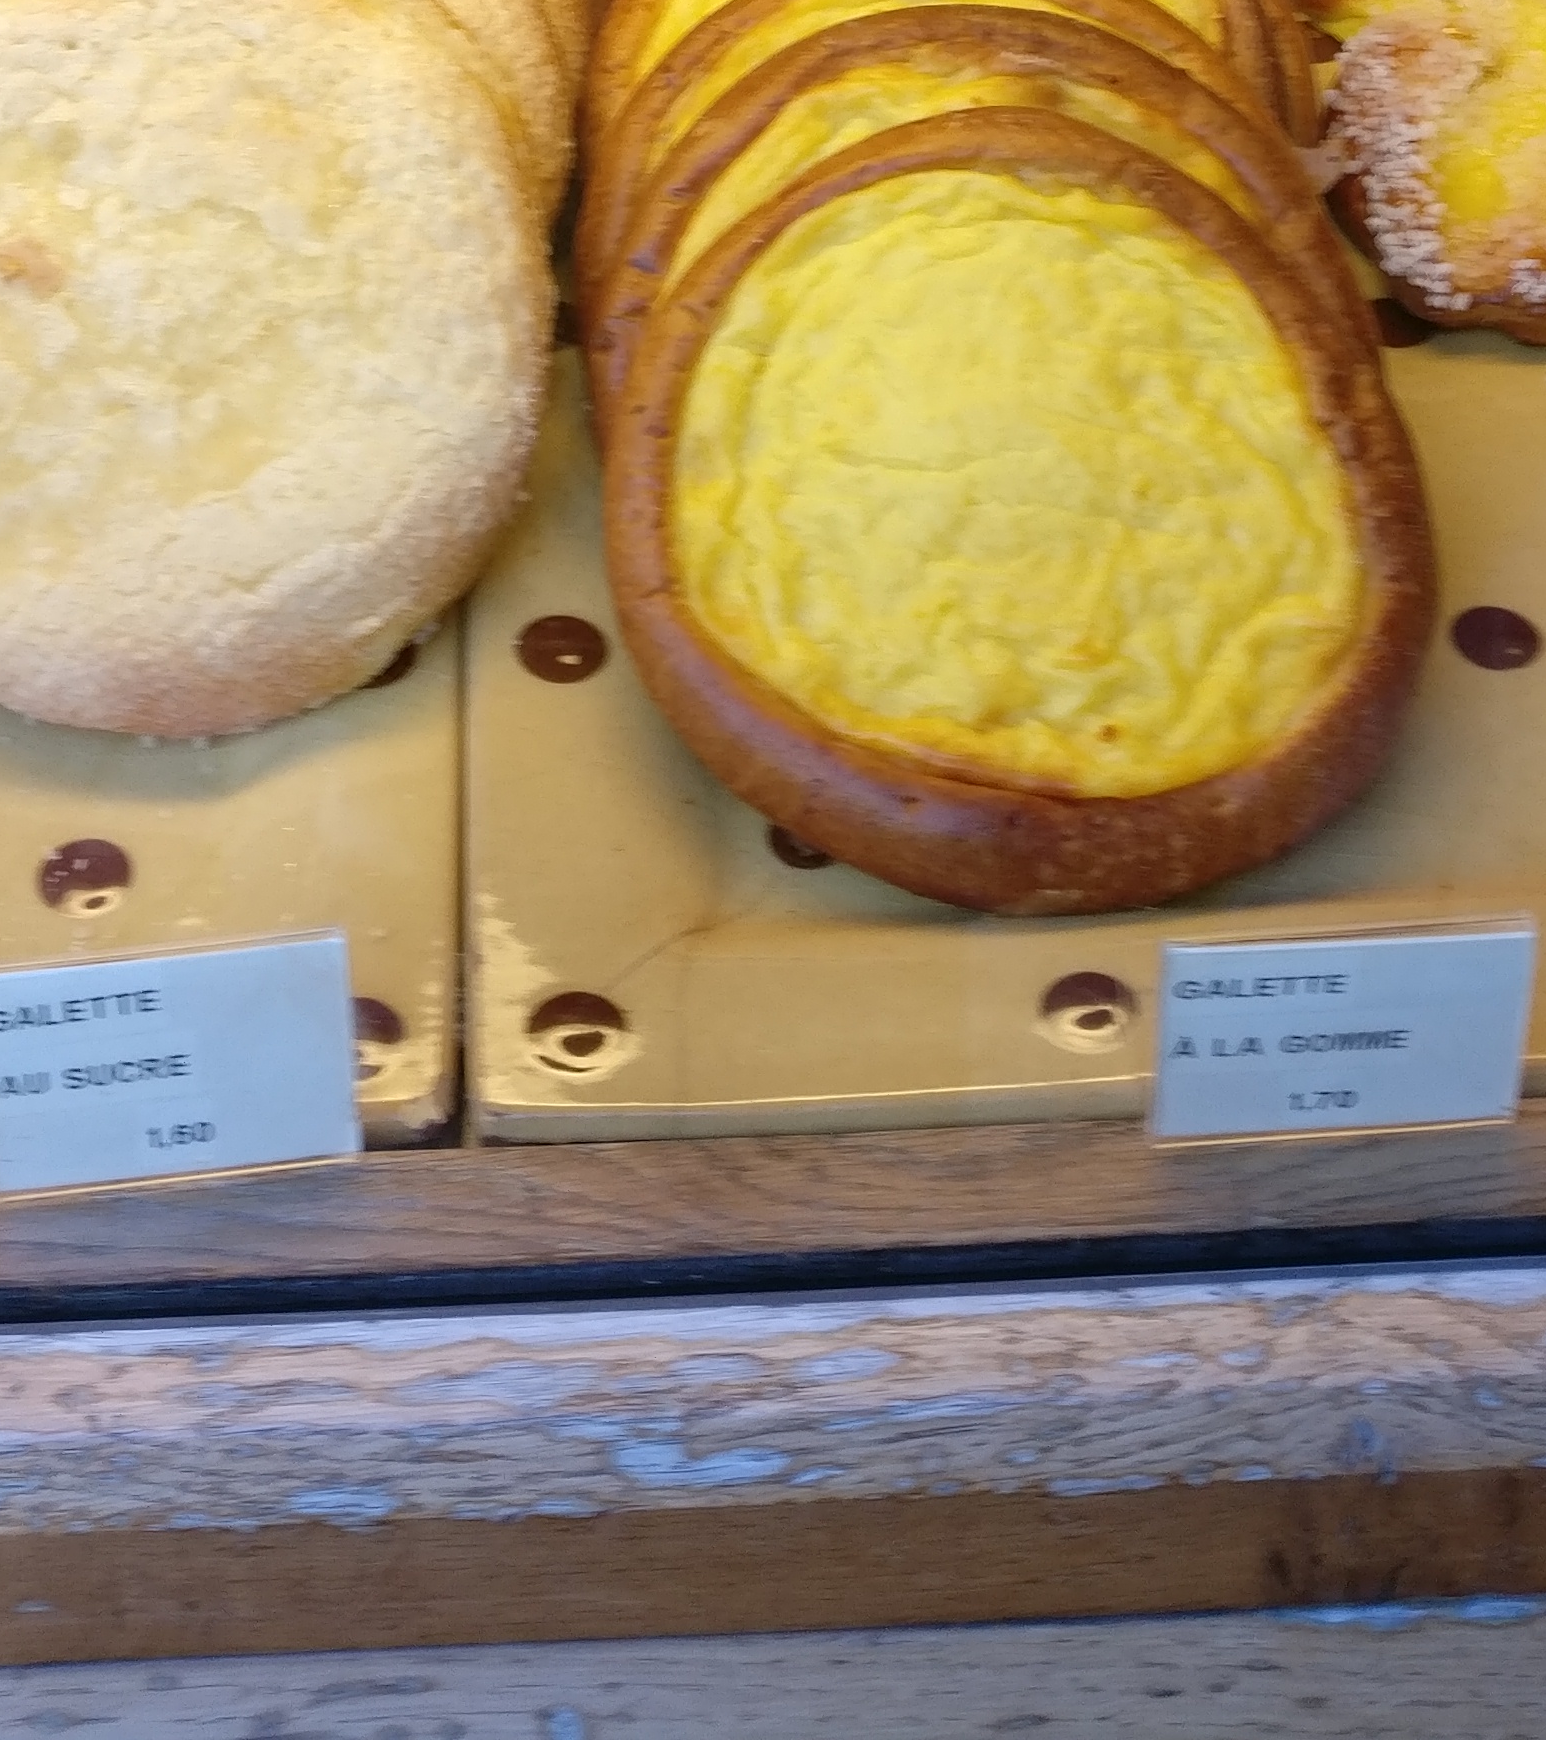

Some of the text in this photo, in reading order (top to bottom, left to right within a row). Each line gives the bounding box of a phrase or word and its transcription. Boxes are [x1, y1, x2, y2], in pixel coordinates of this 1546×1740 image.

[1171, 973, 1349, 999] GALETTE
[1210, 1036, 1265, 1057] LA
[61, 1054, 193, 1089] SUCRE
